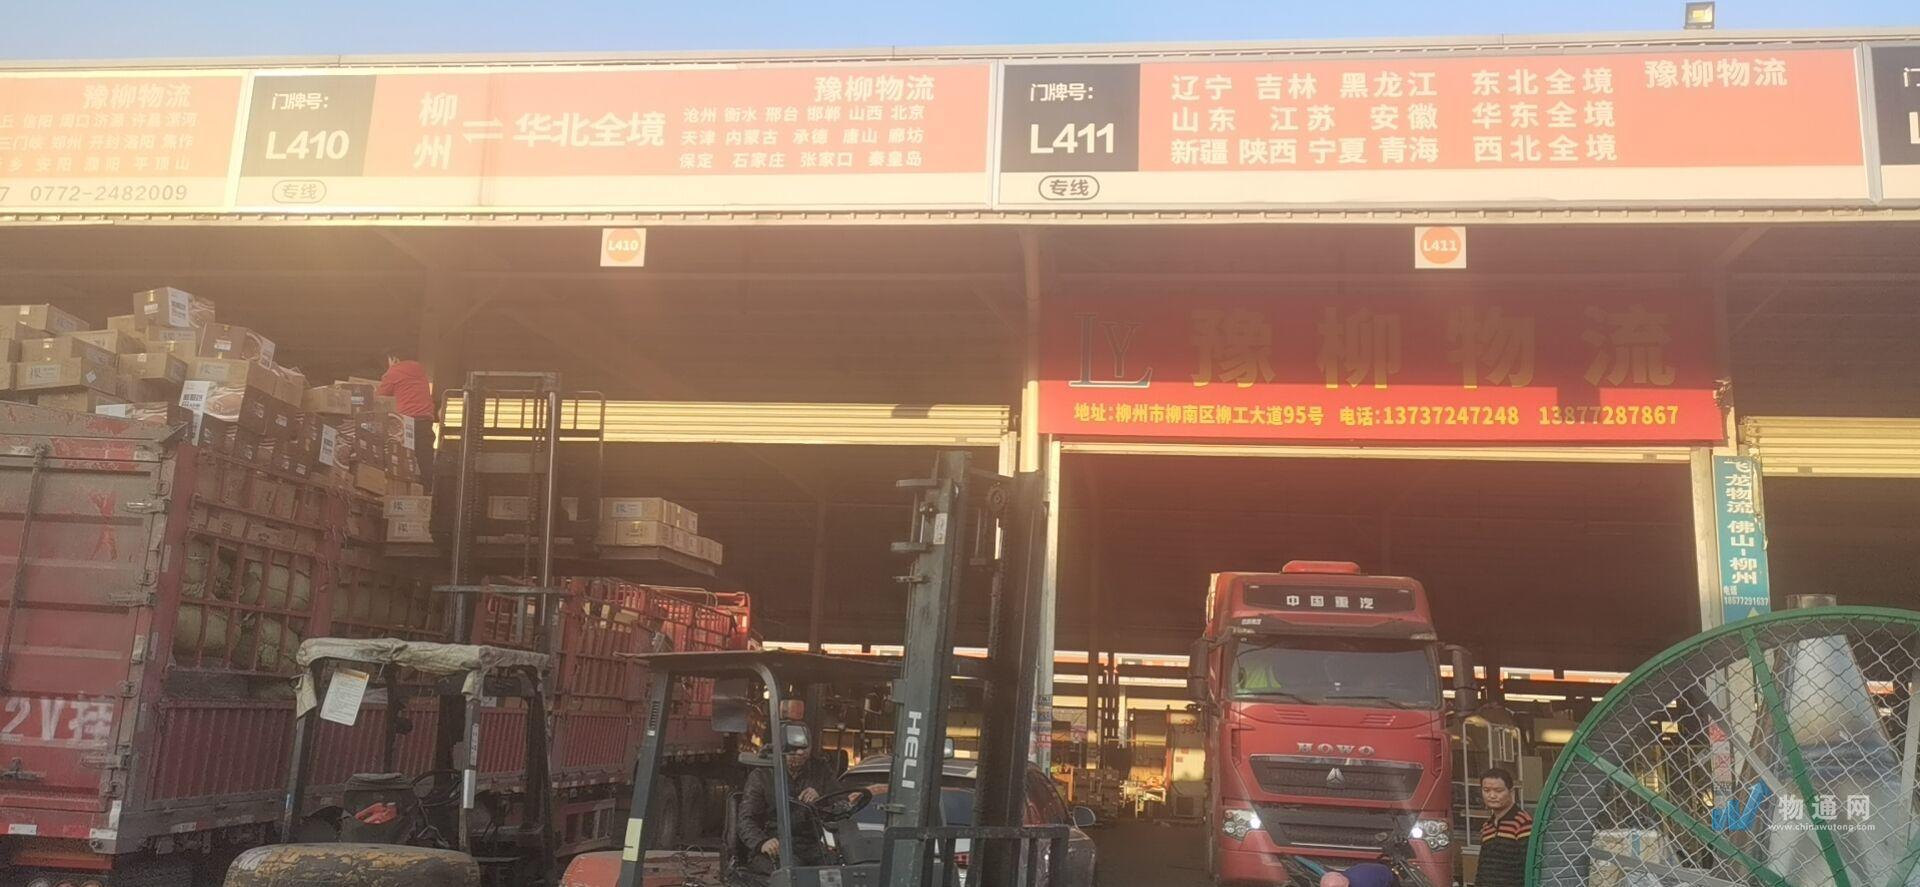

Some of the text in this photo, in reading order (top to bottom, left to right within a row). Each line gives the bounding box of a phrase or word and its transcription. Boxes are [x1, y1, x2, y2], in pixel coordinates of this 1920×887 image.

[1645, 57, 1788, 88] 豫柳物流
[814, 75, 935, 102] 豫柳物流
[1031, 83, 1094, 103] 门牌号:
[1171, 67, 1614, 101] 辽宁 吉林 黑龙江 东北全境
[82, 83, 192, 109] 豫柳物流
[272, 92, 329, 110] 门牌号:
[23, 114, 52, 129] 信阳
[59, 113, 89, 129] 周口
[132, 112, 161, 128] 许昌
[684, 104, 925, 124] 沧州 衡水 邢台 邯郸 山西 北京
[1172, 100, 1615, 133] 山东 江苏 安徽 华东全境
[413, 92, 458, 170] 柳州
[514, 112, 666, 148] 华北全境
[681, 128, 924, 146] 天津 内蒙古 承德 唐山 廊坊
[1030, 123, 1115, 154] L411
[51, 136, 82, 151] 郑州
[162, 134, 193, 151] 焦作
[265, 130, 349, 160] L410
[1170, 133, 1618, 166] 新疆 陕西 宁夏 青海 西北全境
[133, 156, 190, 172] 平顶山
[680, 150, 922, 169] 保定 石家庄 张家口 秦皇岛
[30, 185, 188, 202] 0772-2482009
[282, 183, 318, 200] 专线
[1049, 179, 1089, 196] 专线
[607, 240, 639, 252] L410
[1422, 239, 1458, 252] L411
[1189, 305, 1677, 390] 豫柳物流
[1073, 403, 1678, 427] 地址:柳州市柳南区柳工大道95号 电话:13737247248 13877287867
[1723, 460, 1754, 514] 飞龙物流
[1286, 595, 1375, 610] 中国重汽
[901, 711, 923, 789] HELI
[1296, 742, 1376, 756] HOWO
